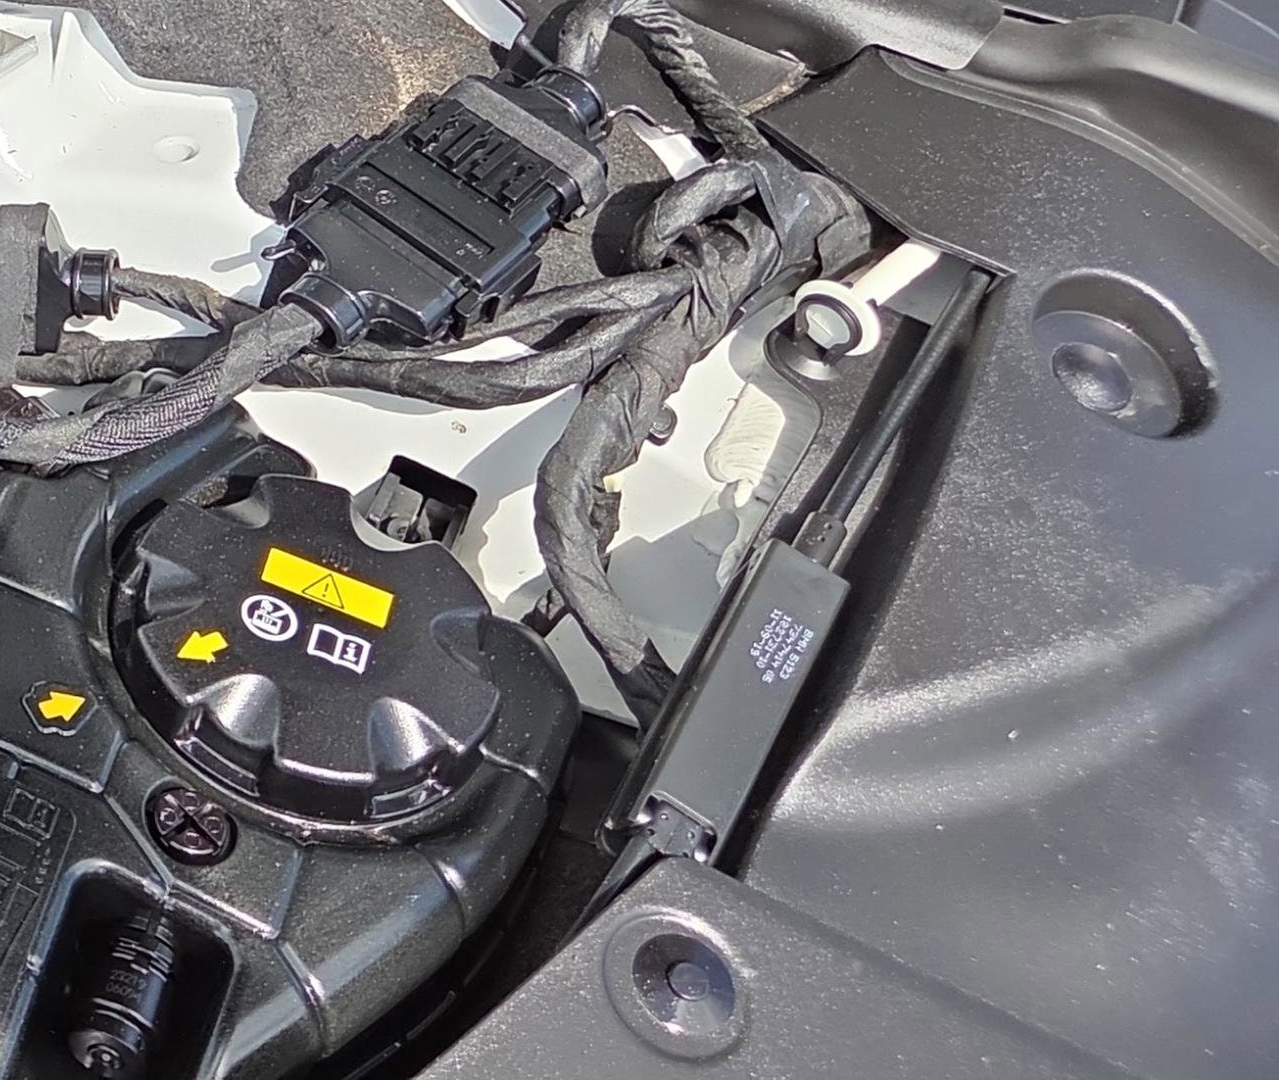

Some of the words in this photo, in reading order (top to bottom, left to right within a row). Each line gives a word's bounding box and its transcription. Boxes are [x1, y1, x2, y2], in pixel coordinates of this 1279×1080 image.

[771, 623, 803, 668] 7347414
[795, 628, 814, 652] BMW
[779, 652, 800, 680] 5123
